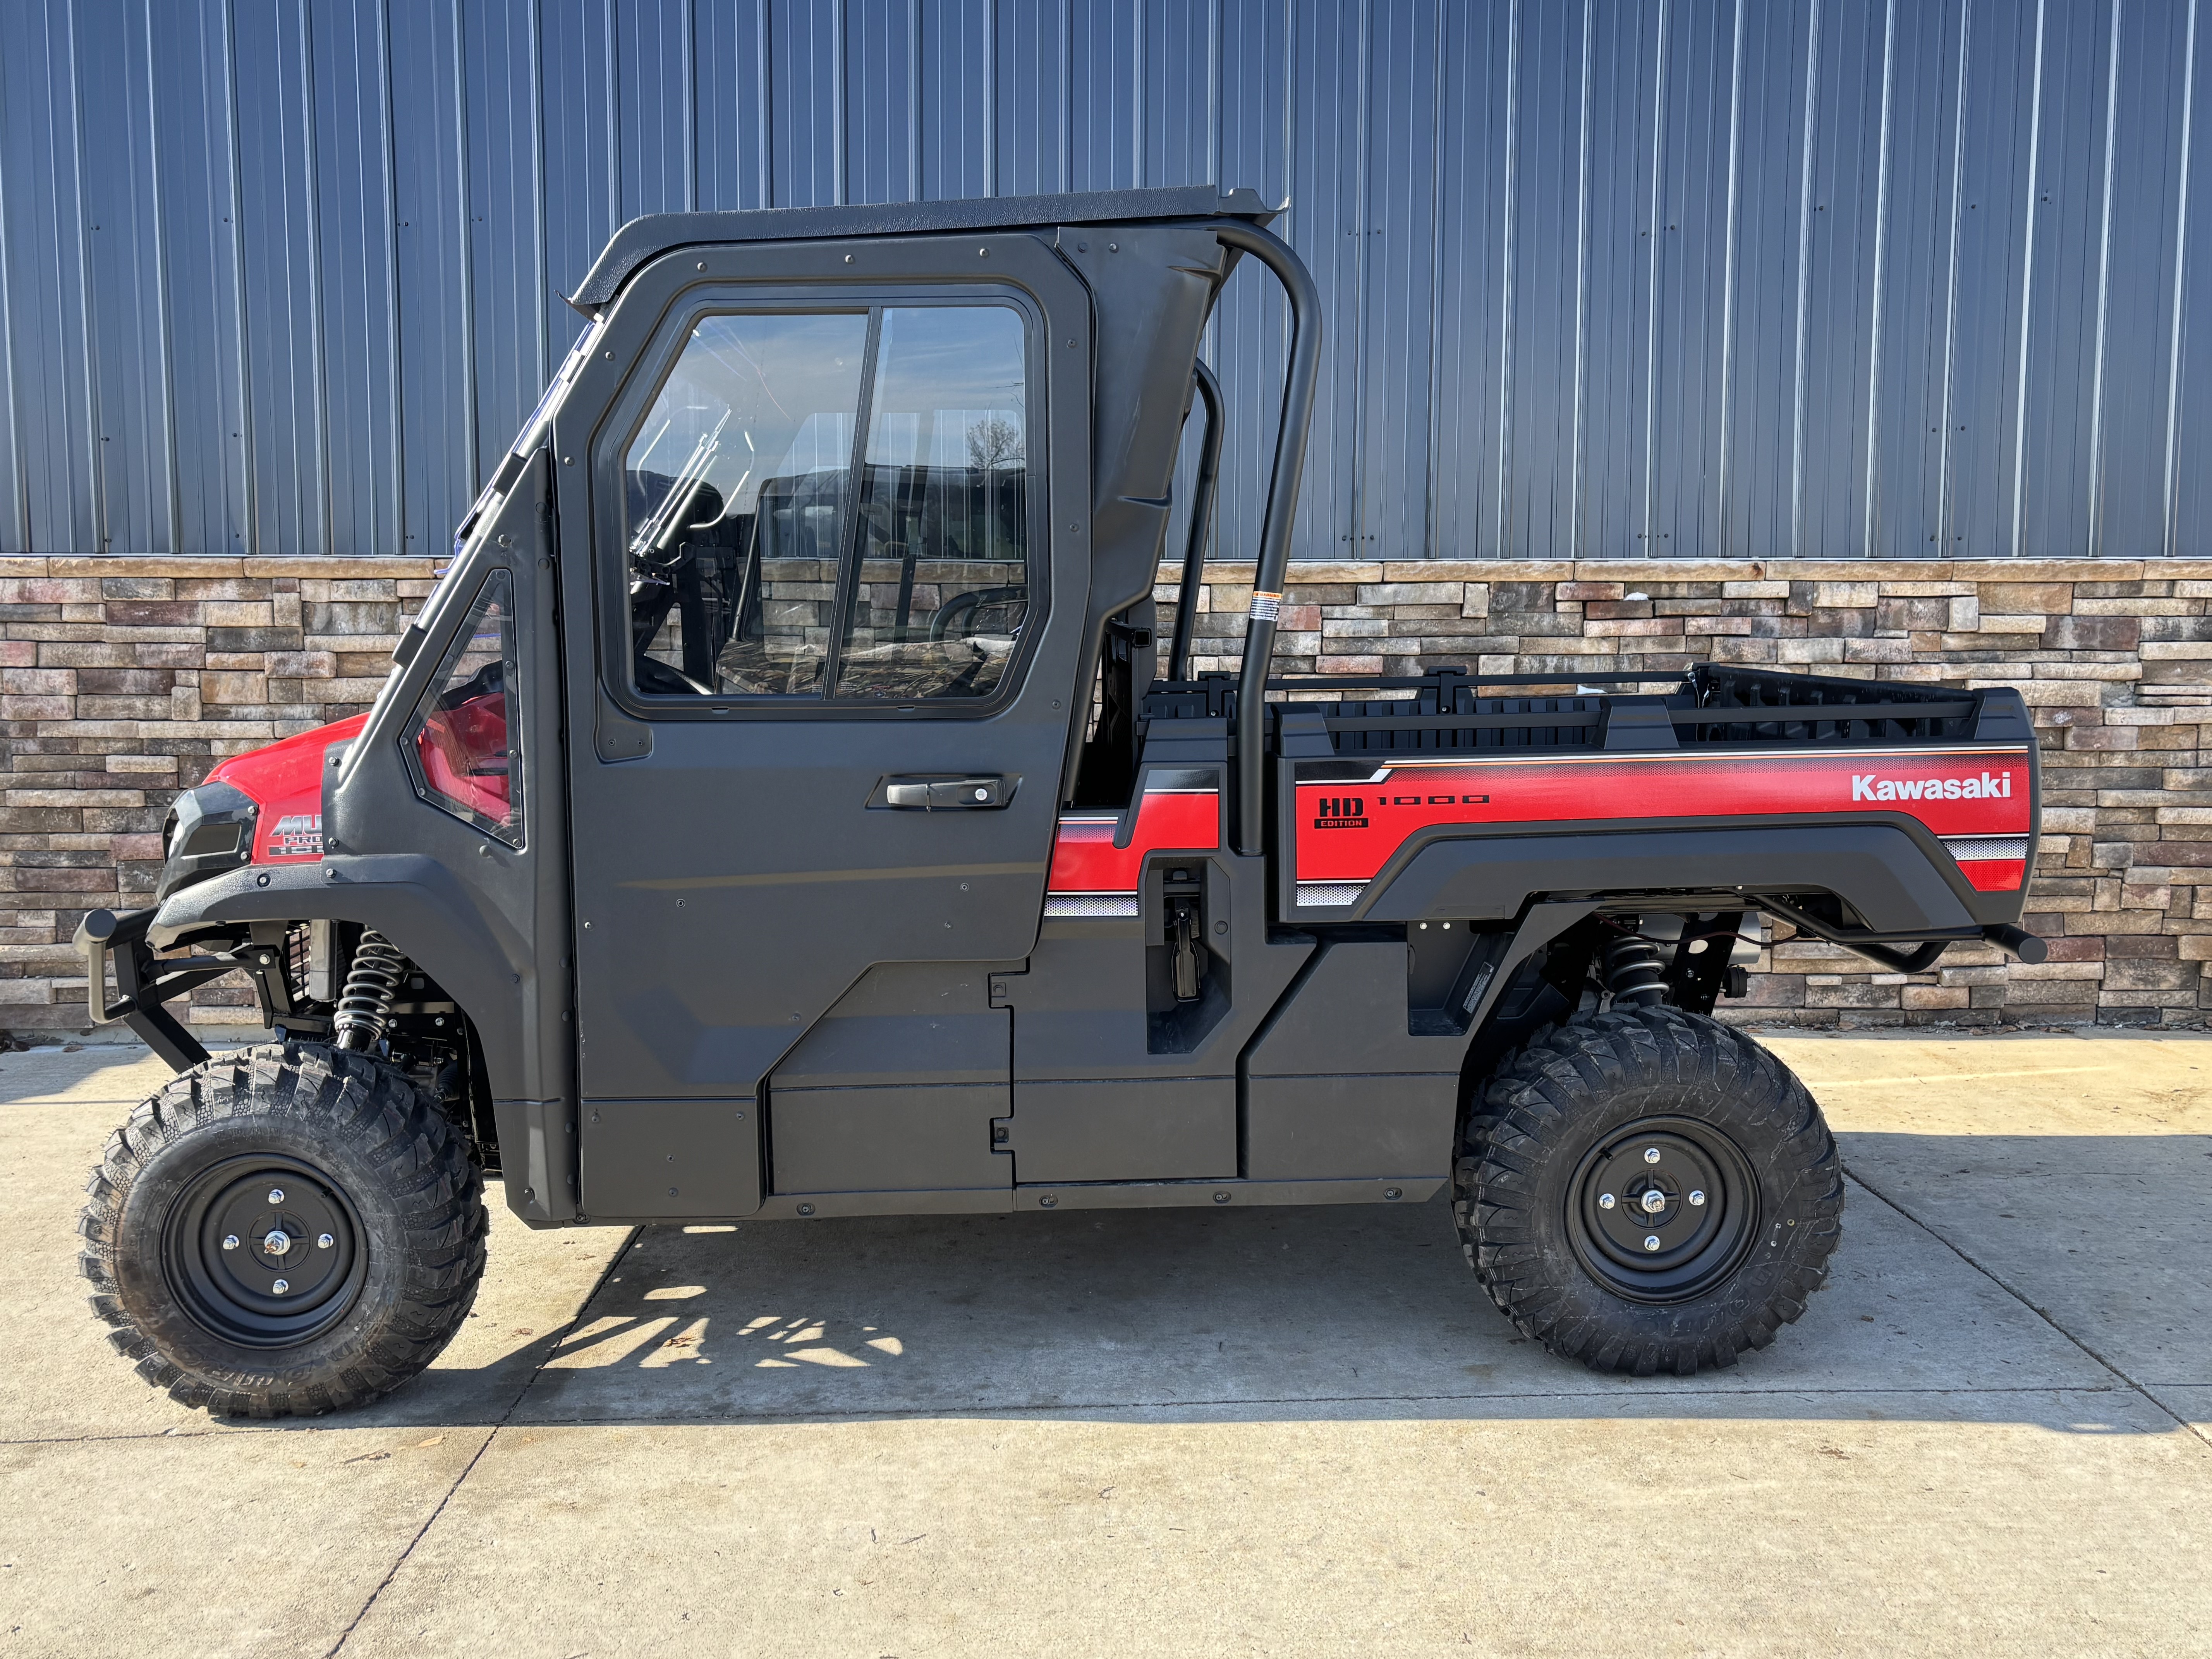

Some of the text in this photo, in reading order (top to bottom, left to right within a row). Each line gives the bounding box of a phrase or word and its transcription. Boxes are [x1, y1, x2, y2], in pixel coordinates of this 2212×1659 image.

[1852, 772, 2010, 801] Kawasaki
[1319, 797, 1363, 817] HD
[1377, 795, 1489, 805] 1000
